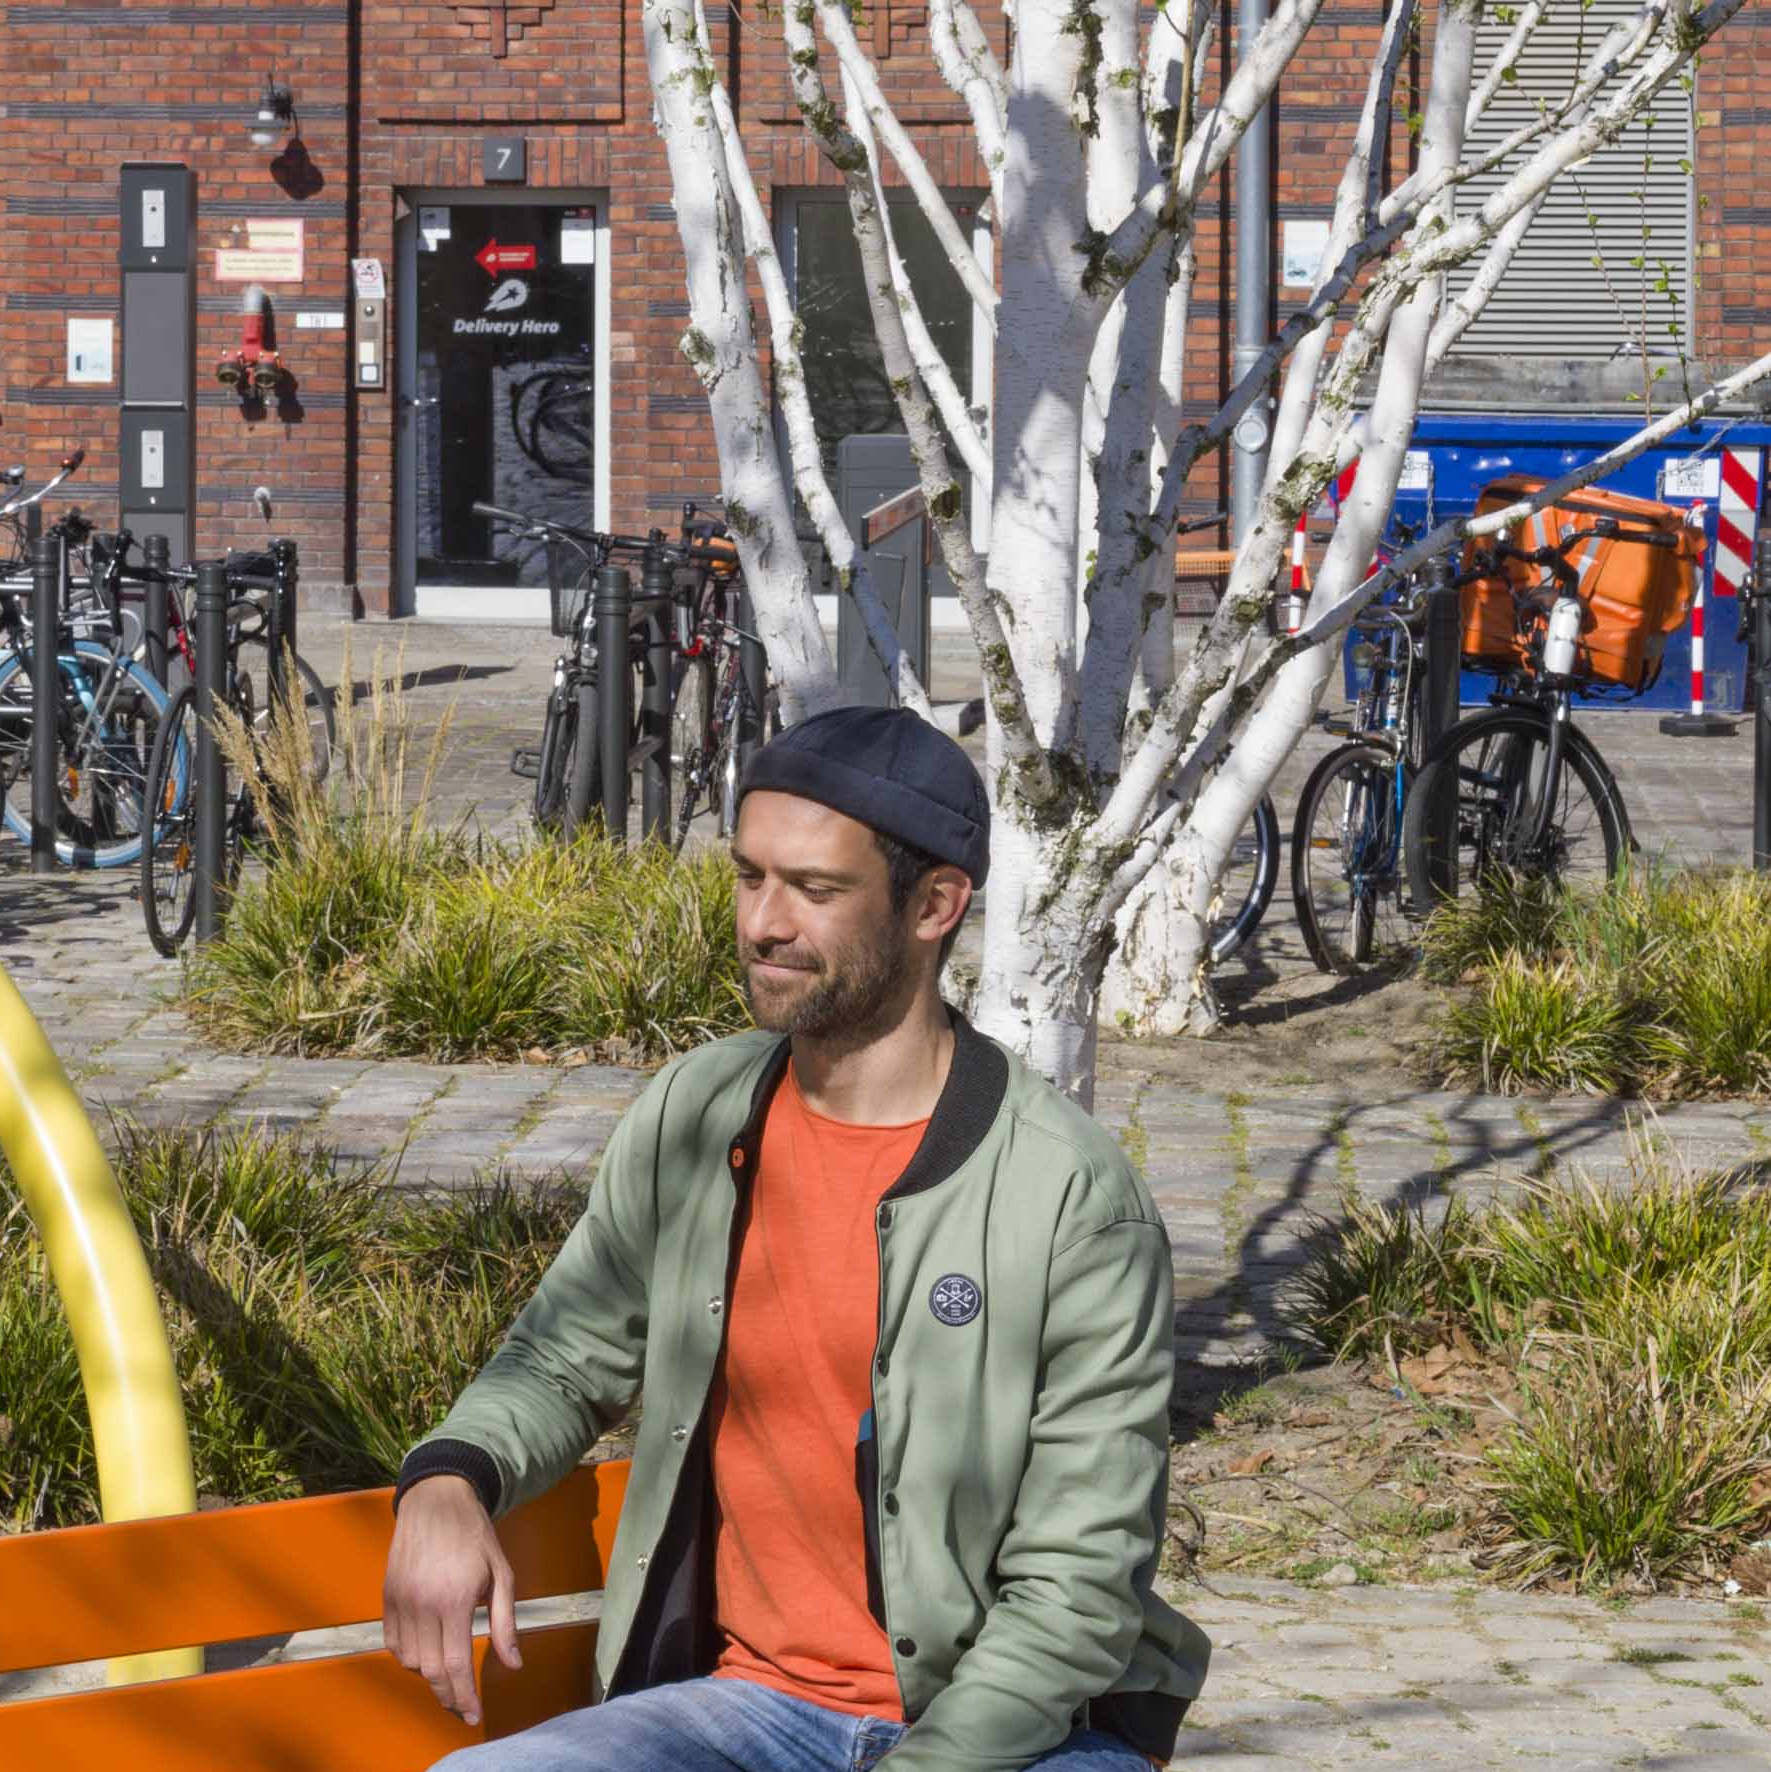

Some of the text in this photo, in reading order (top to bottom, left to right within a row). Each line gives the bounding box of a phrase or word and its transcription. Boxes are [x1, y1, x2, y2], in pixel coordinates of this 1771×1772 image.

[496, 147, 512, 170] 7
[453, 318, 560, 336] Delivery Hero
